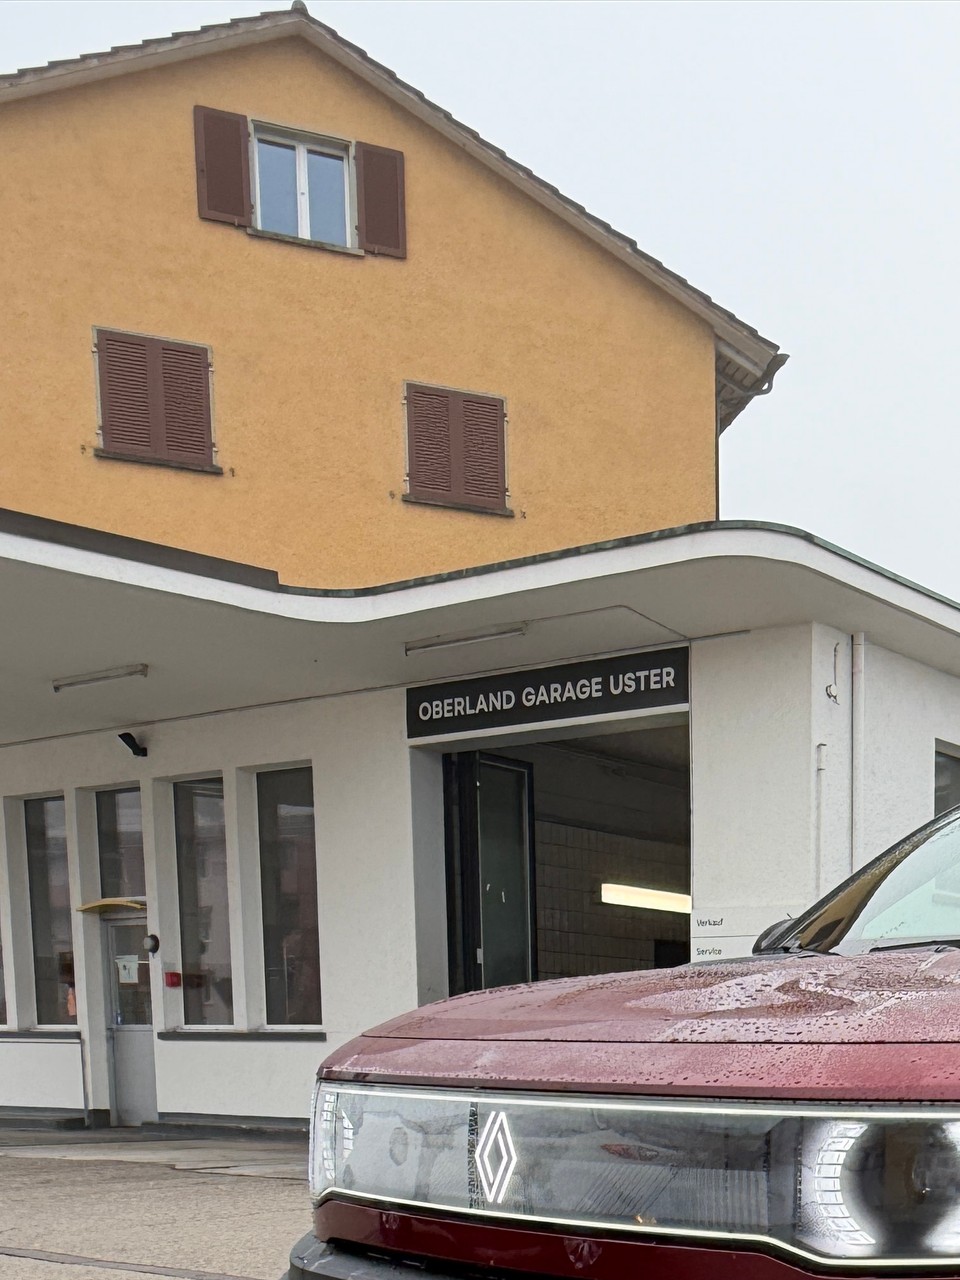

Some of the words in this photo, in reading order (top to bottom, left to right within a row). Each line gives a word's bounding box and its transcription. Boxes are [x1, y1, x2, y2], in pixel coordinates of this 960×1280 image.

[418, 690, 516, 721] OBERLAND
[521, 677, 603, 707] GARAGE
[609, 667, 675, 695] USTER
